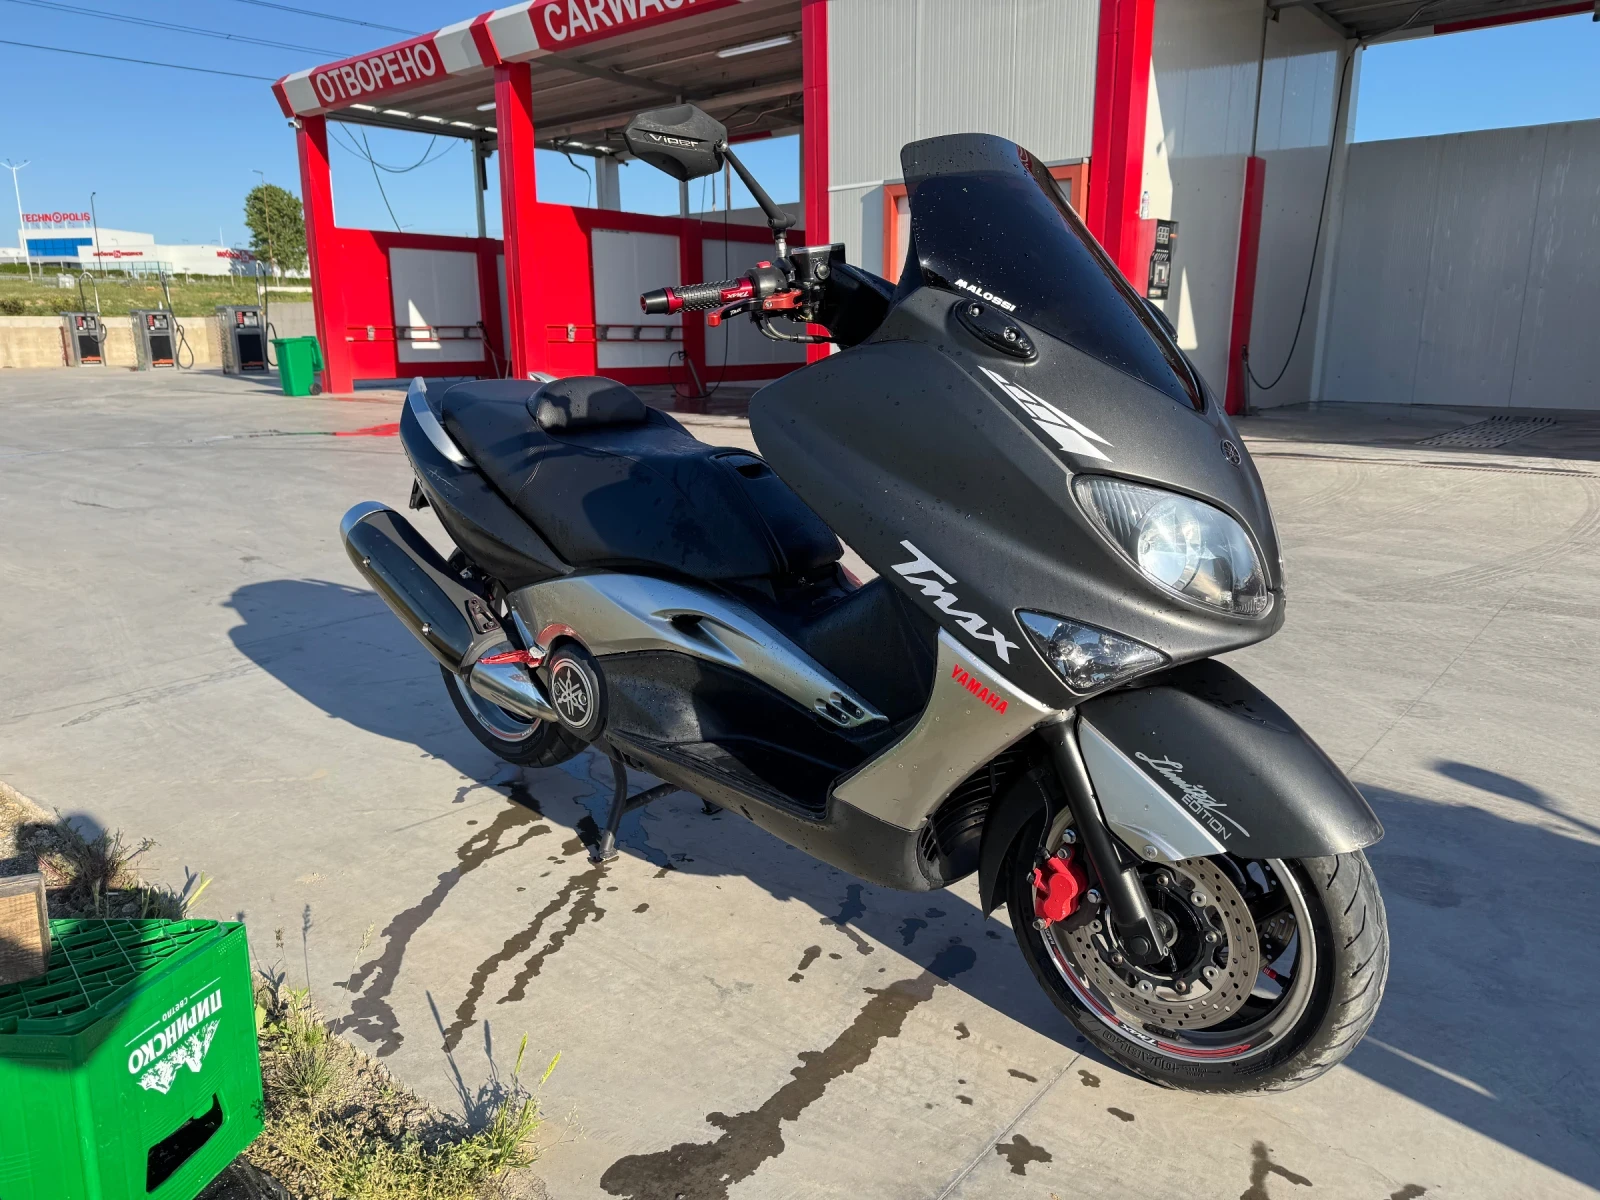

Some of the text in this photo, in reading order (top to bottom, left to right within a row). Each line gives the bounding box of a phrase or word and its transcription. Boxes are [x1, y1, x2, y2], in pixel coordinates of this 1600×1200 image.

[316, 44, 436, 103] ОТВОРЕНО
[954, 278, 1017, 312] MALOSSI
[950, 664, 1009, 715] YAMAHA
[1181, 793, 1232, 841] EDITION
[128, 988, 222, 1075] ПИРИНСКО
